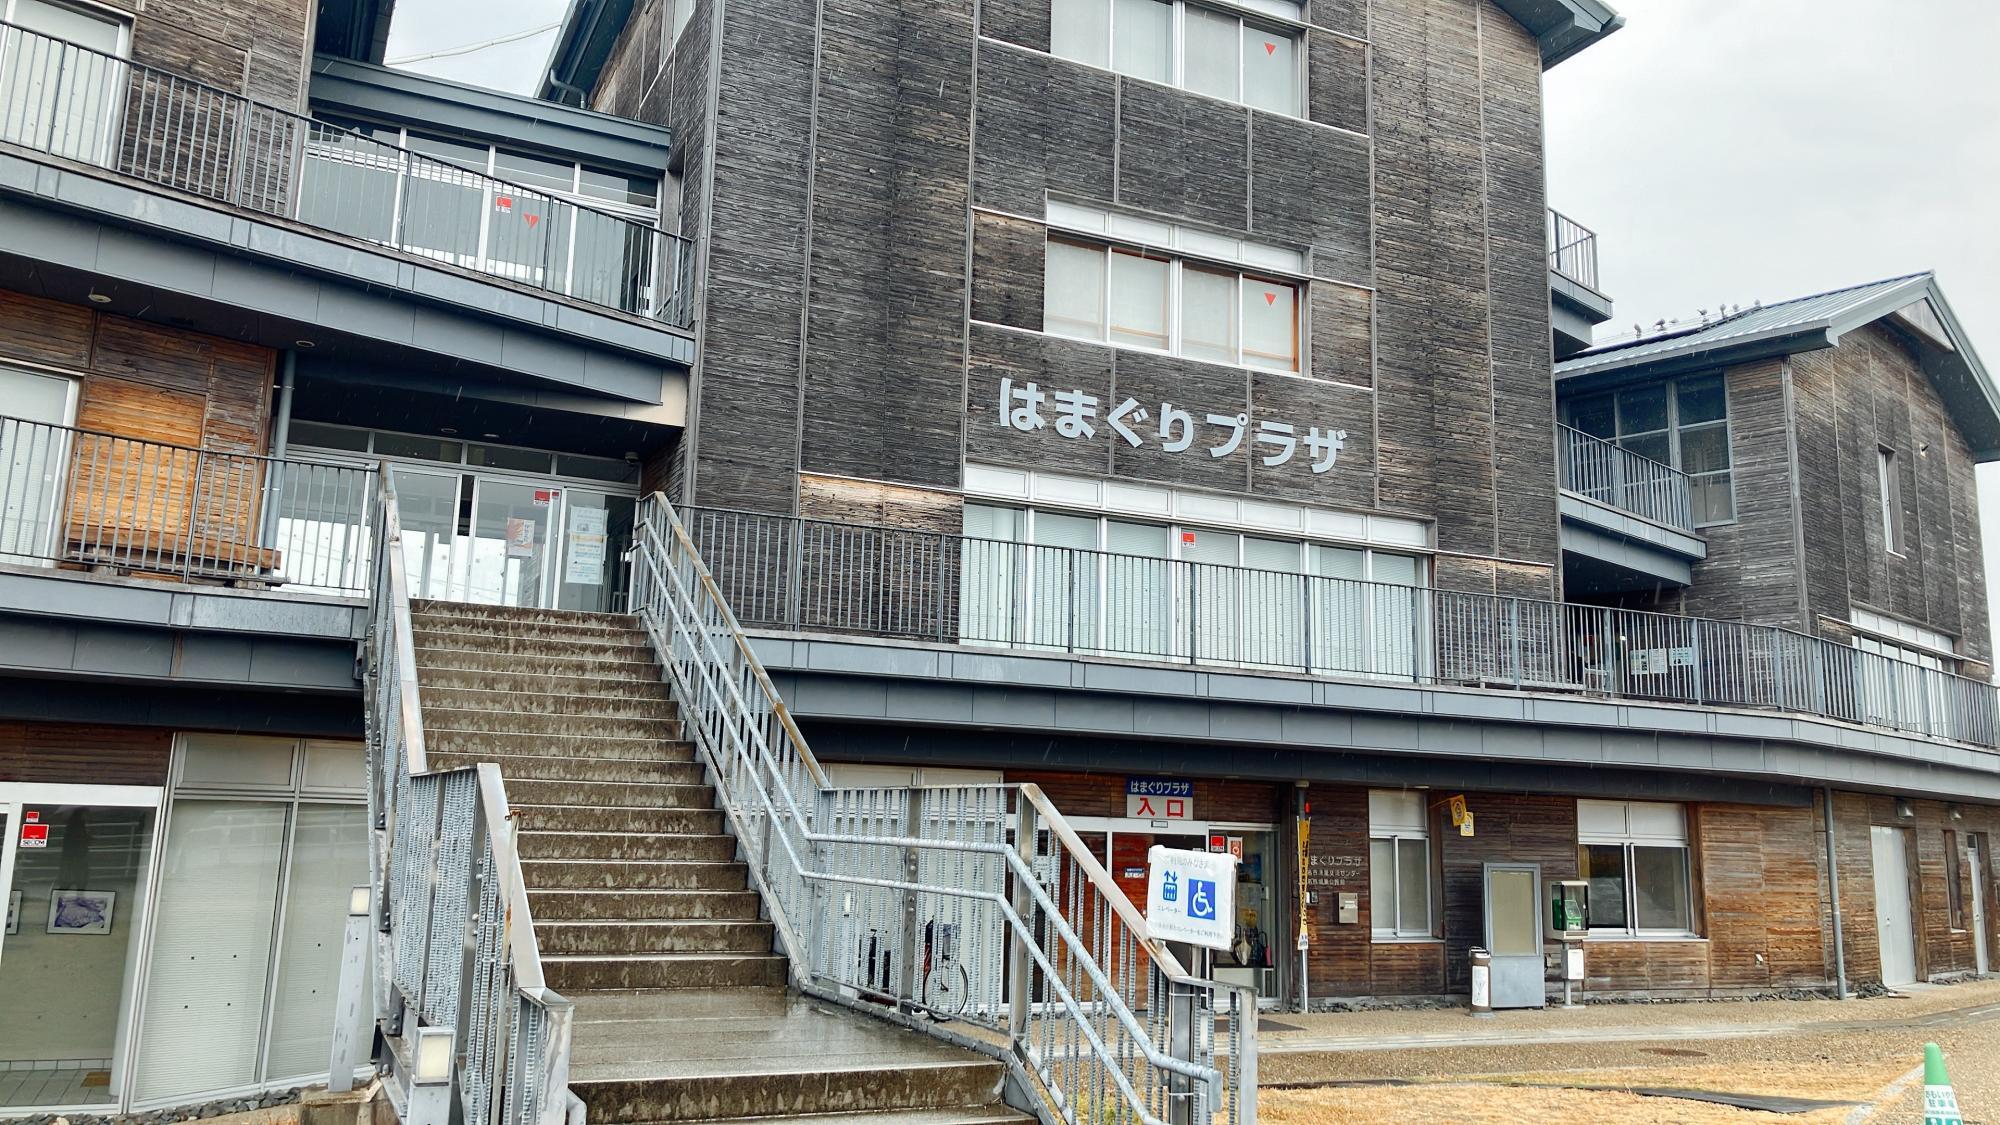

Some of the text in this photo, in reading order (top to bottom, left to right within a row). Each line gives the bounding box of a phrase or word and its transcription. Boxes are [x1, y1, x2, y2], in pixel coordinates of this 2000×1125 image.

[999, 376, 1349, 475] はまぐりプラザ
[1130, 780, 1190, 796] はまぐりプラザ
[1136, 797, 1185, 818] 入口
[1308, 854, 1363, 867] まぐりプラザ
